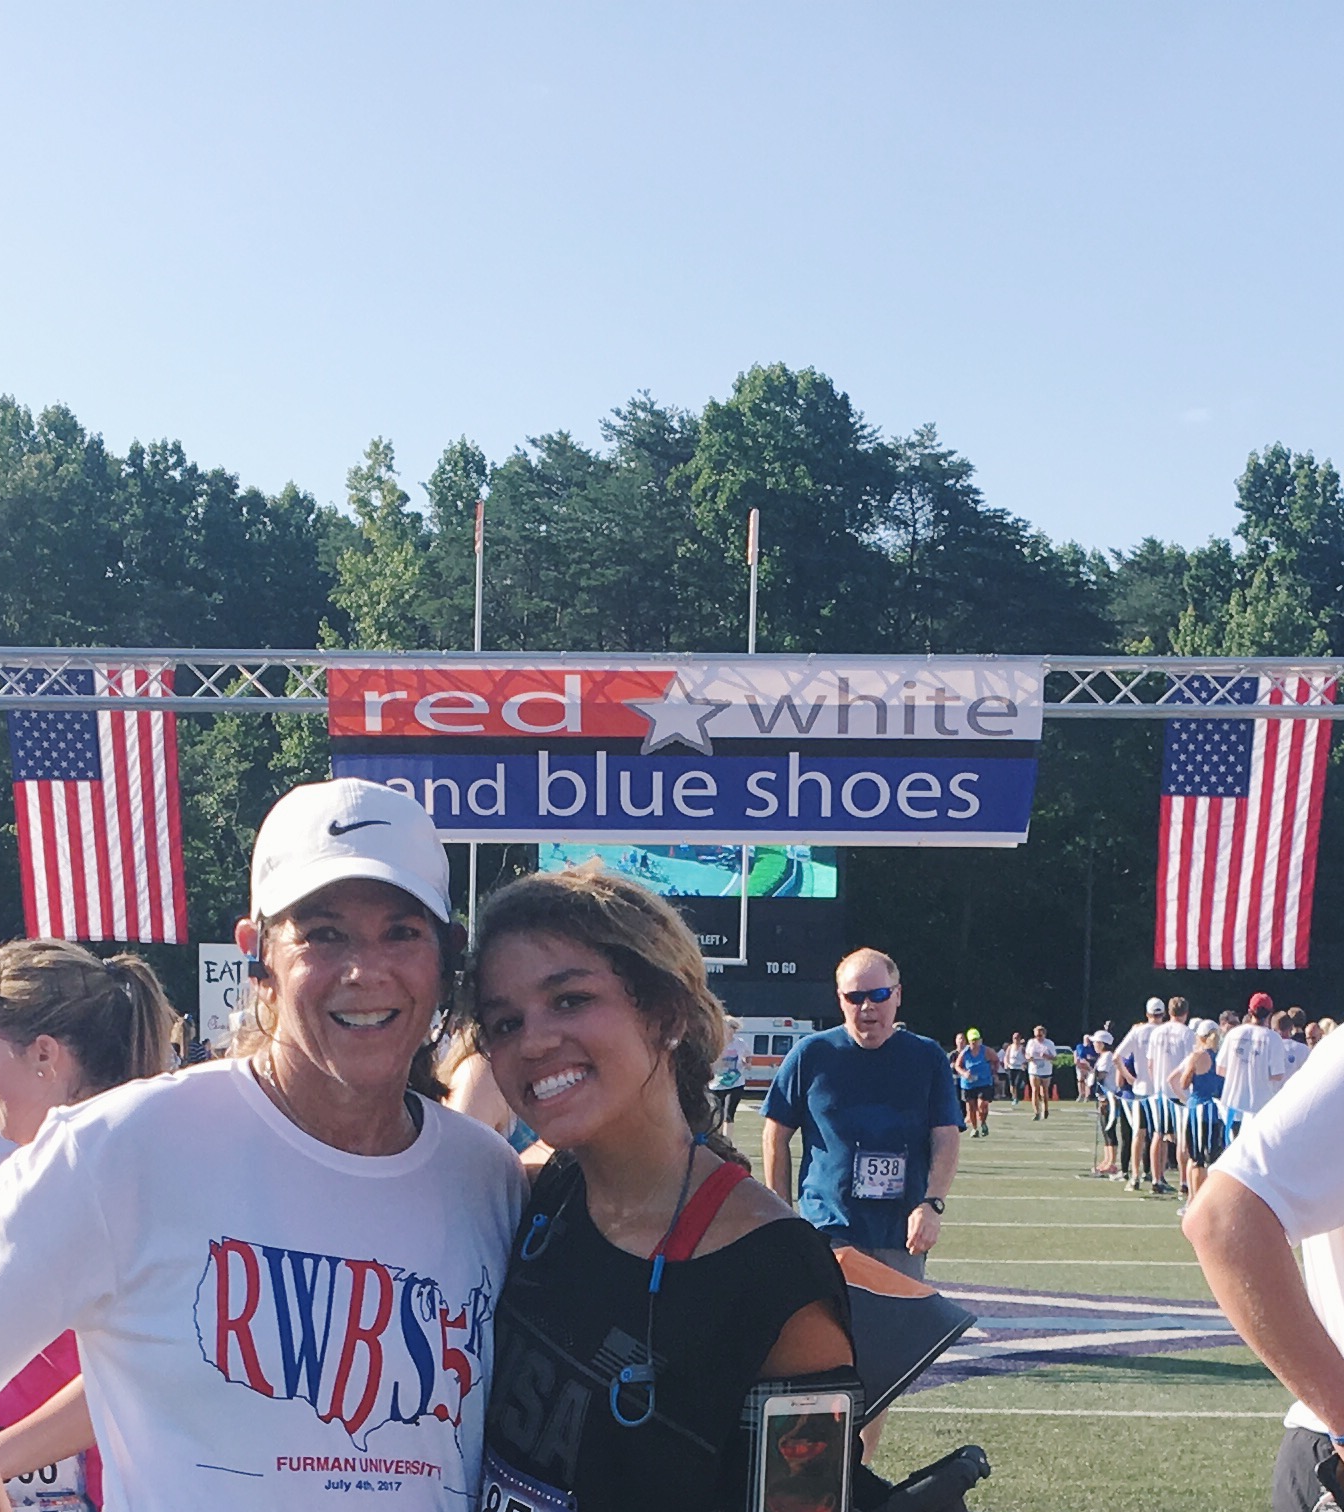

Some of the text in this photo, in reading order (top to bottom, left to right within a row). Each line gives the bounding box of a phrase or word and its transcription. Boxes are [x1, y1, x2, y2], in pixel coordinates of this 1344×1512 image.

[364, 674, 582, 733] red
[744, 676, 1018, 736] white
[538, 750, 718, 818] blue
[745, 751, 981, 819] shoes
[204, 960, 243, 985] EAT
[766, 961, 796, 974] TO GO
[867, 1158, 899, 1176] 538
[276, 1456, 356, 1472] FURMAN
[324, 1479, 352, 1492] July
[377, 1480, 402, 1492] 2017
